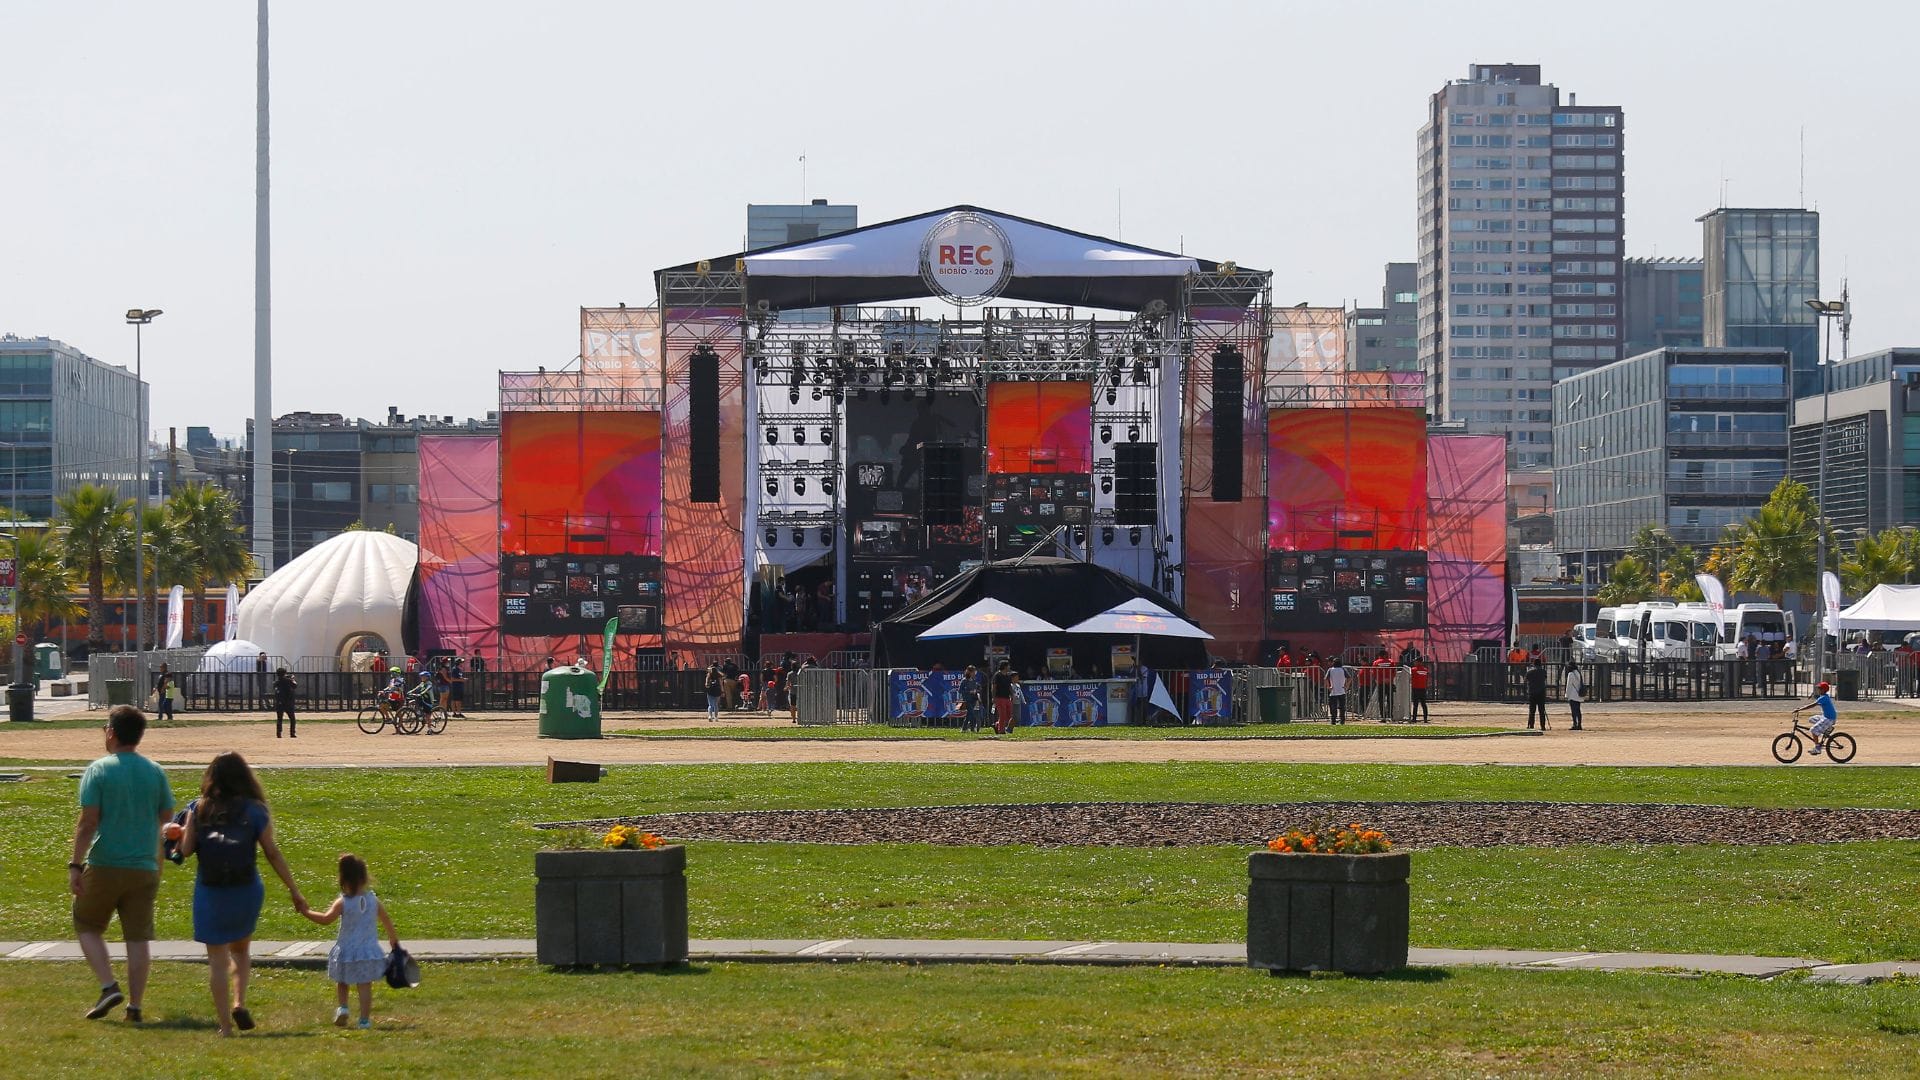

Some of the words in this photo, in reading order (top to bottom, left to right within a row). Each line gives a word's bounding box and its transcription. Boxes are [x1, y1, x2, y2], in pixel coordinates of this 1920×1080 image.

[939, 245, 993, 266] REC
[588, 332, 656, 356] REC
[1269, 331, 1338, 358] REC
